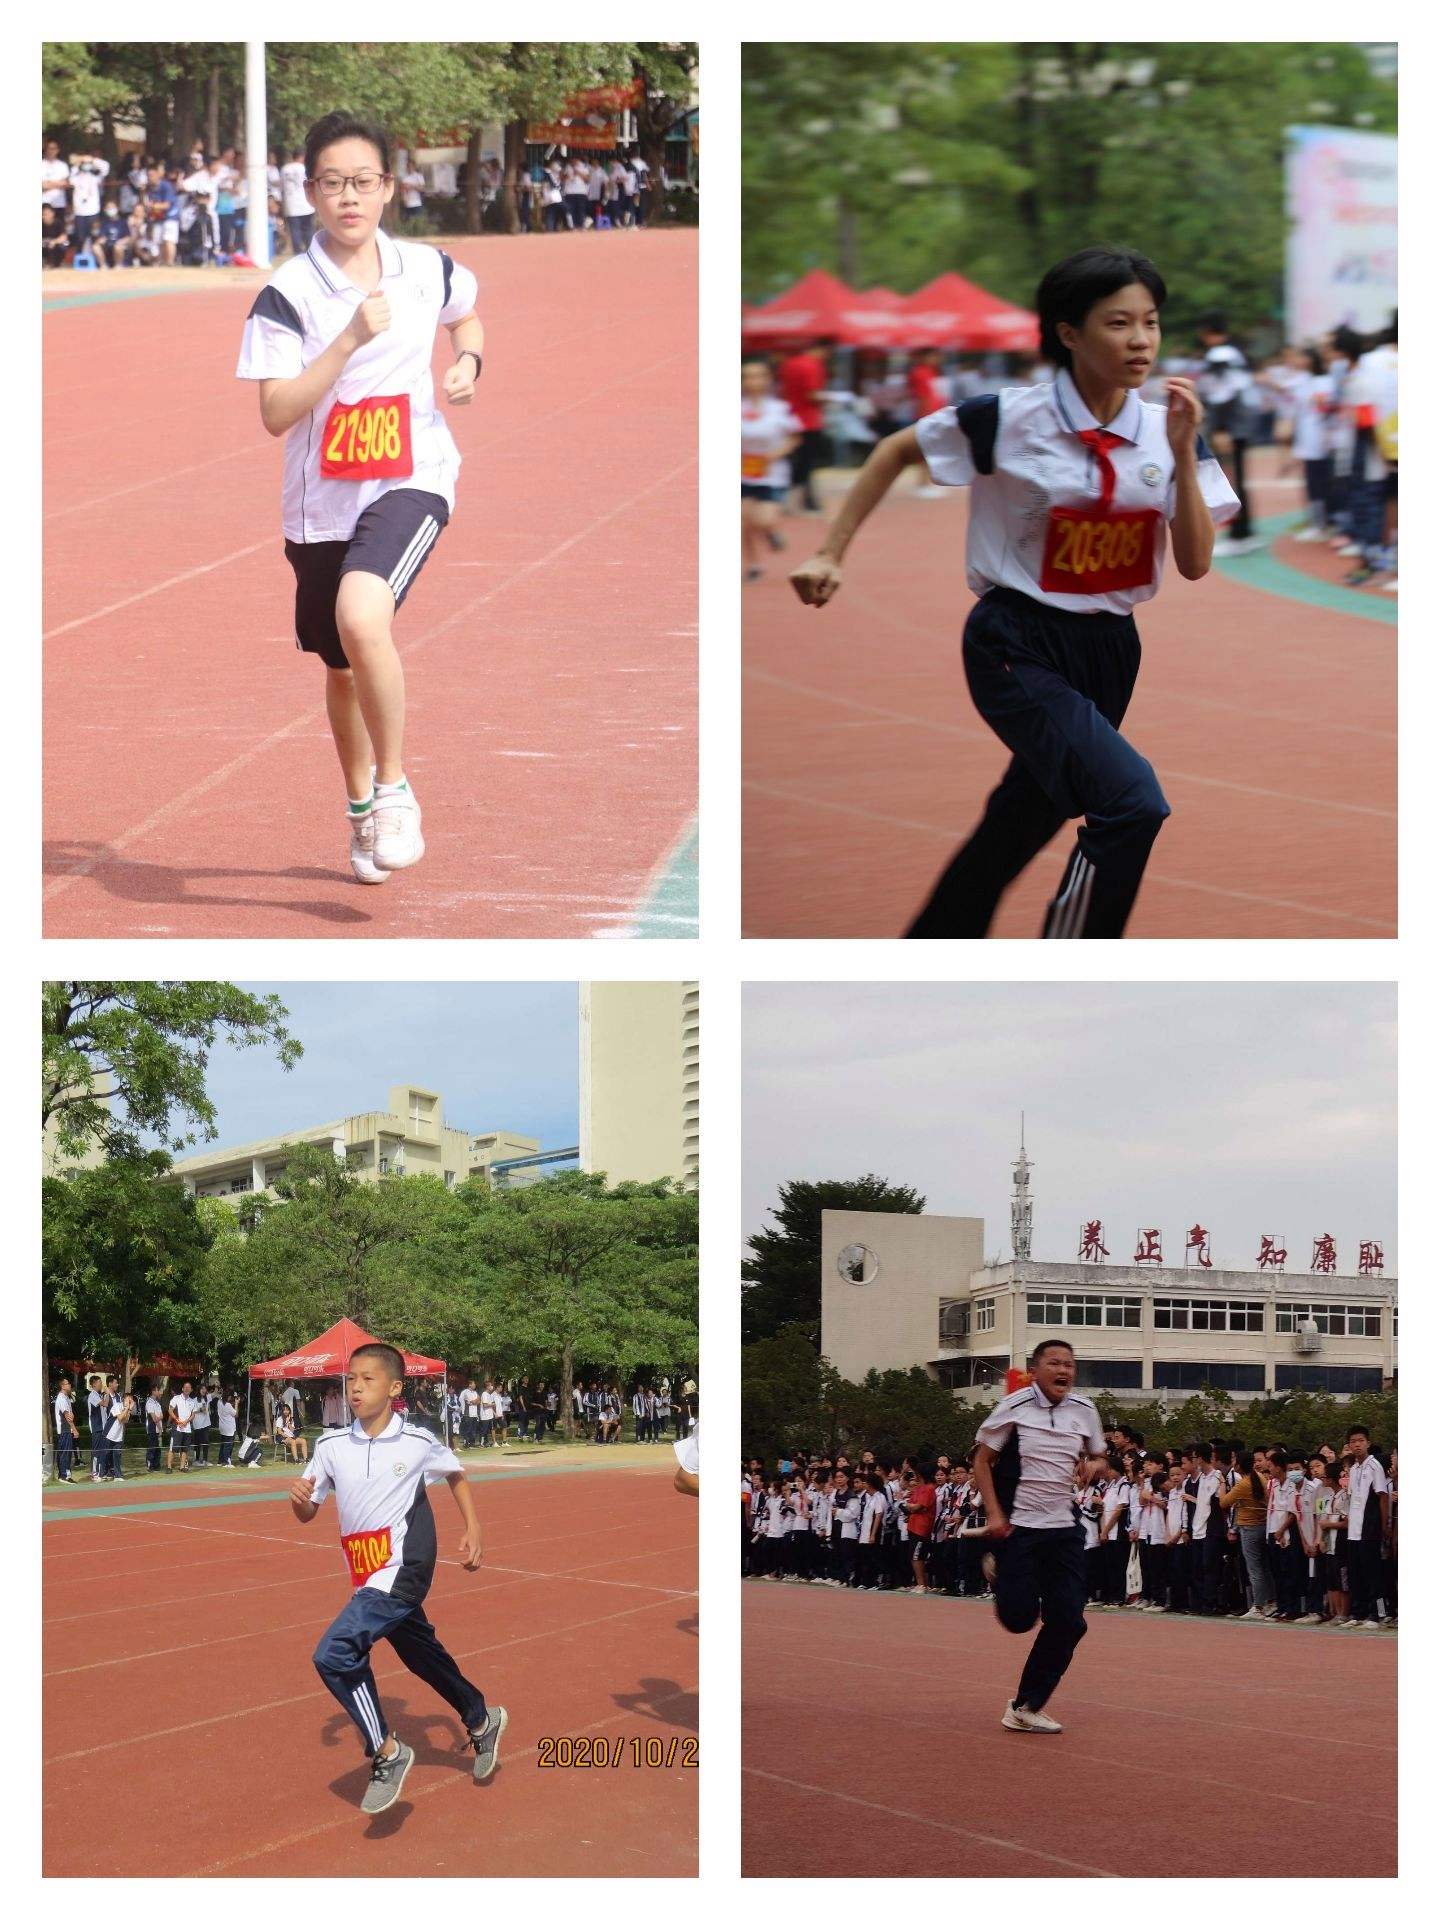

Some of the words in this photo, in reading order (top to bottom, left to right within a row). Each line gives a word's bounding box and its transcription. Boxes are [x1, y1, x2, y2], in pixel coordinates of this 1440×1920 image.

[326, 405, 401, 463] 21908
[1052, 520, 1146, 574] 20306
[1078, 1219, 1213, 1267] 养正气
[1256, 1233, 1384, 1275] 知廉耻
